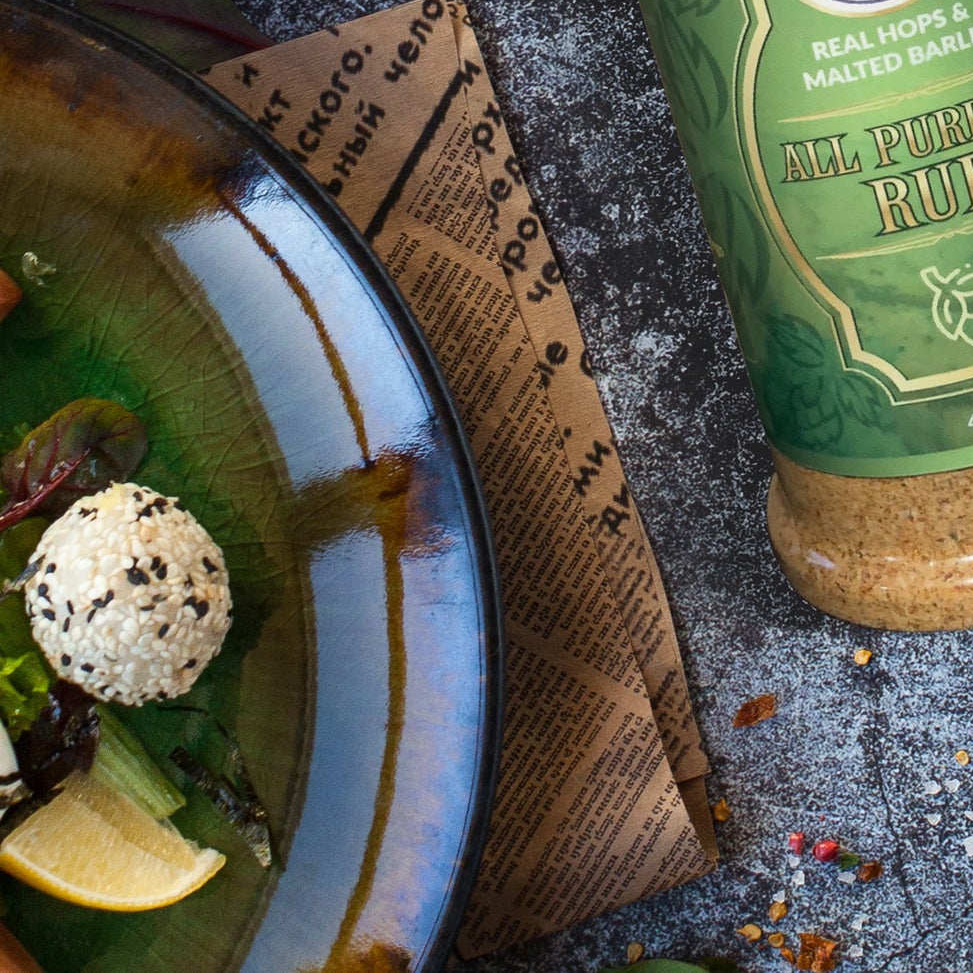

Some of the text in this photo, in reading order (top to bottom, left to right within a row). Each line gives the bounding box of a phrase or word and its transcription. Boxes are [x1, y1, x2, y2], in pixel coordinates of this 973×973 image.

[812, 2, 971, 61] REAL HOPS &
[802, 54, 903, 91] MALTED
[780, 133, 861, 183] ALL
